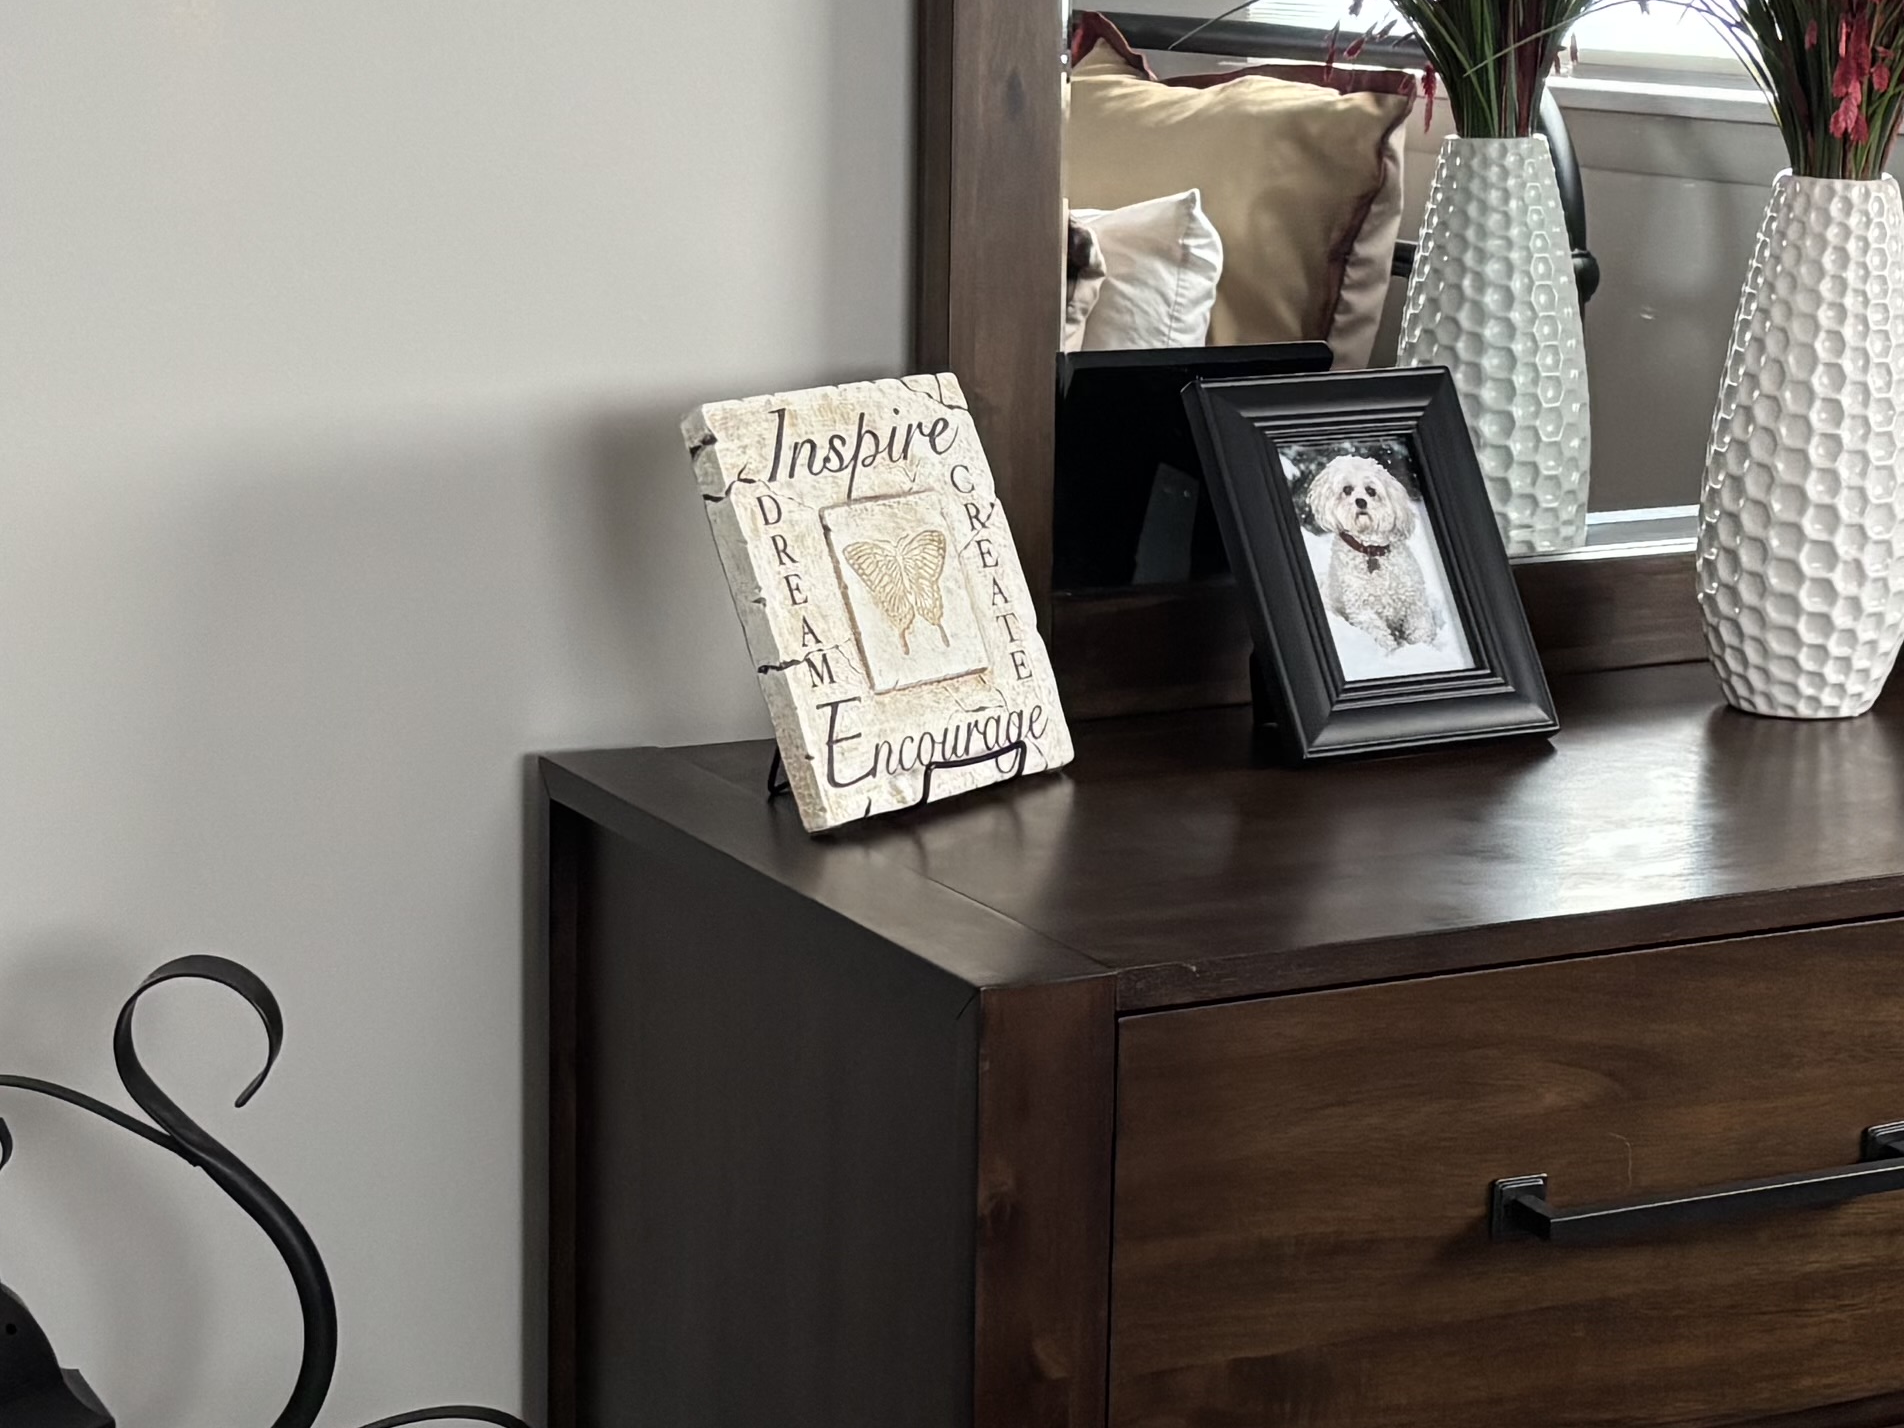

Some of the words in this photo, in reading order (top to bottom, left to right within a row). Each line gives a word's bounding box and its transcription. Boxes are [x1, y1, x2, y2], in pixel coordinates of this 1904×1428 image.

[767, 408, 959, 500] Inspire
[756, 495, 836, 689] DREAM
[949, 463, 1034, 682] CREATE
[815, 695, 1050, 790] Encourage
